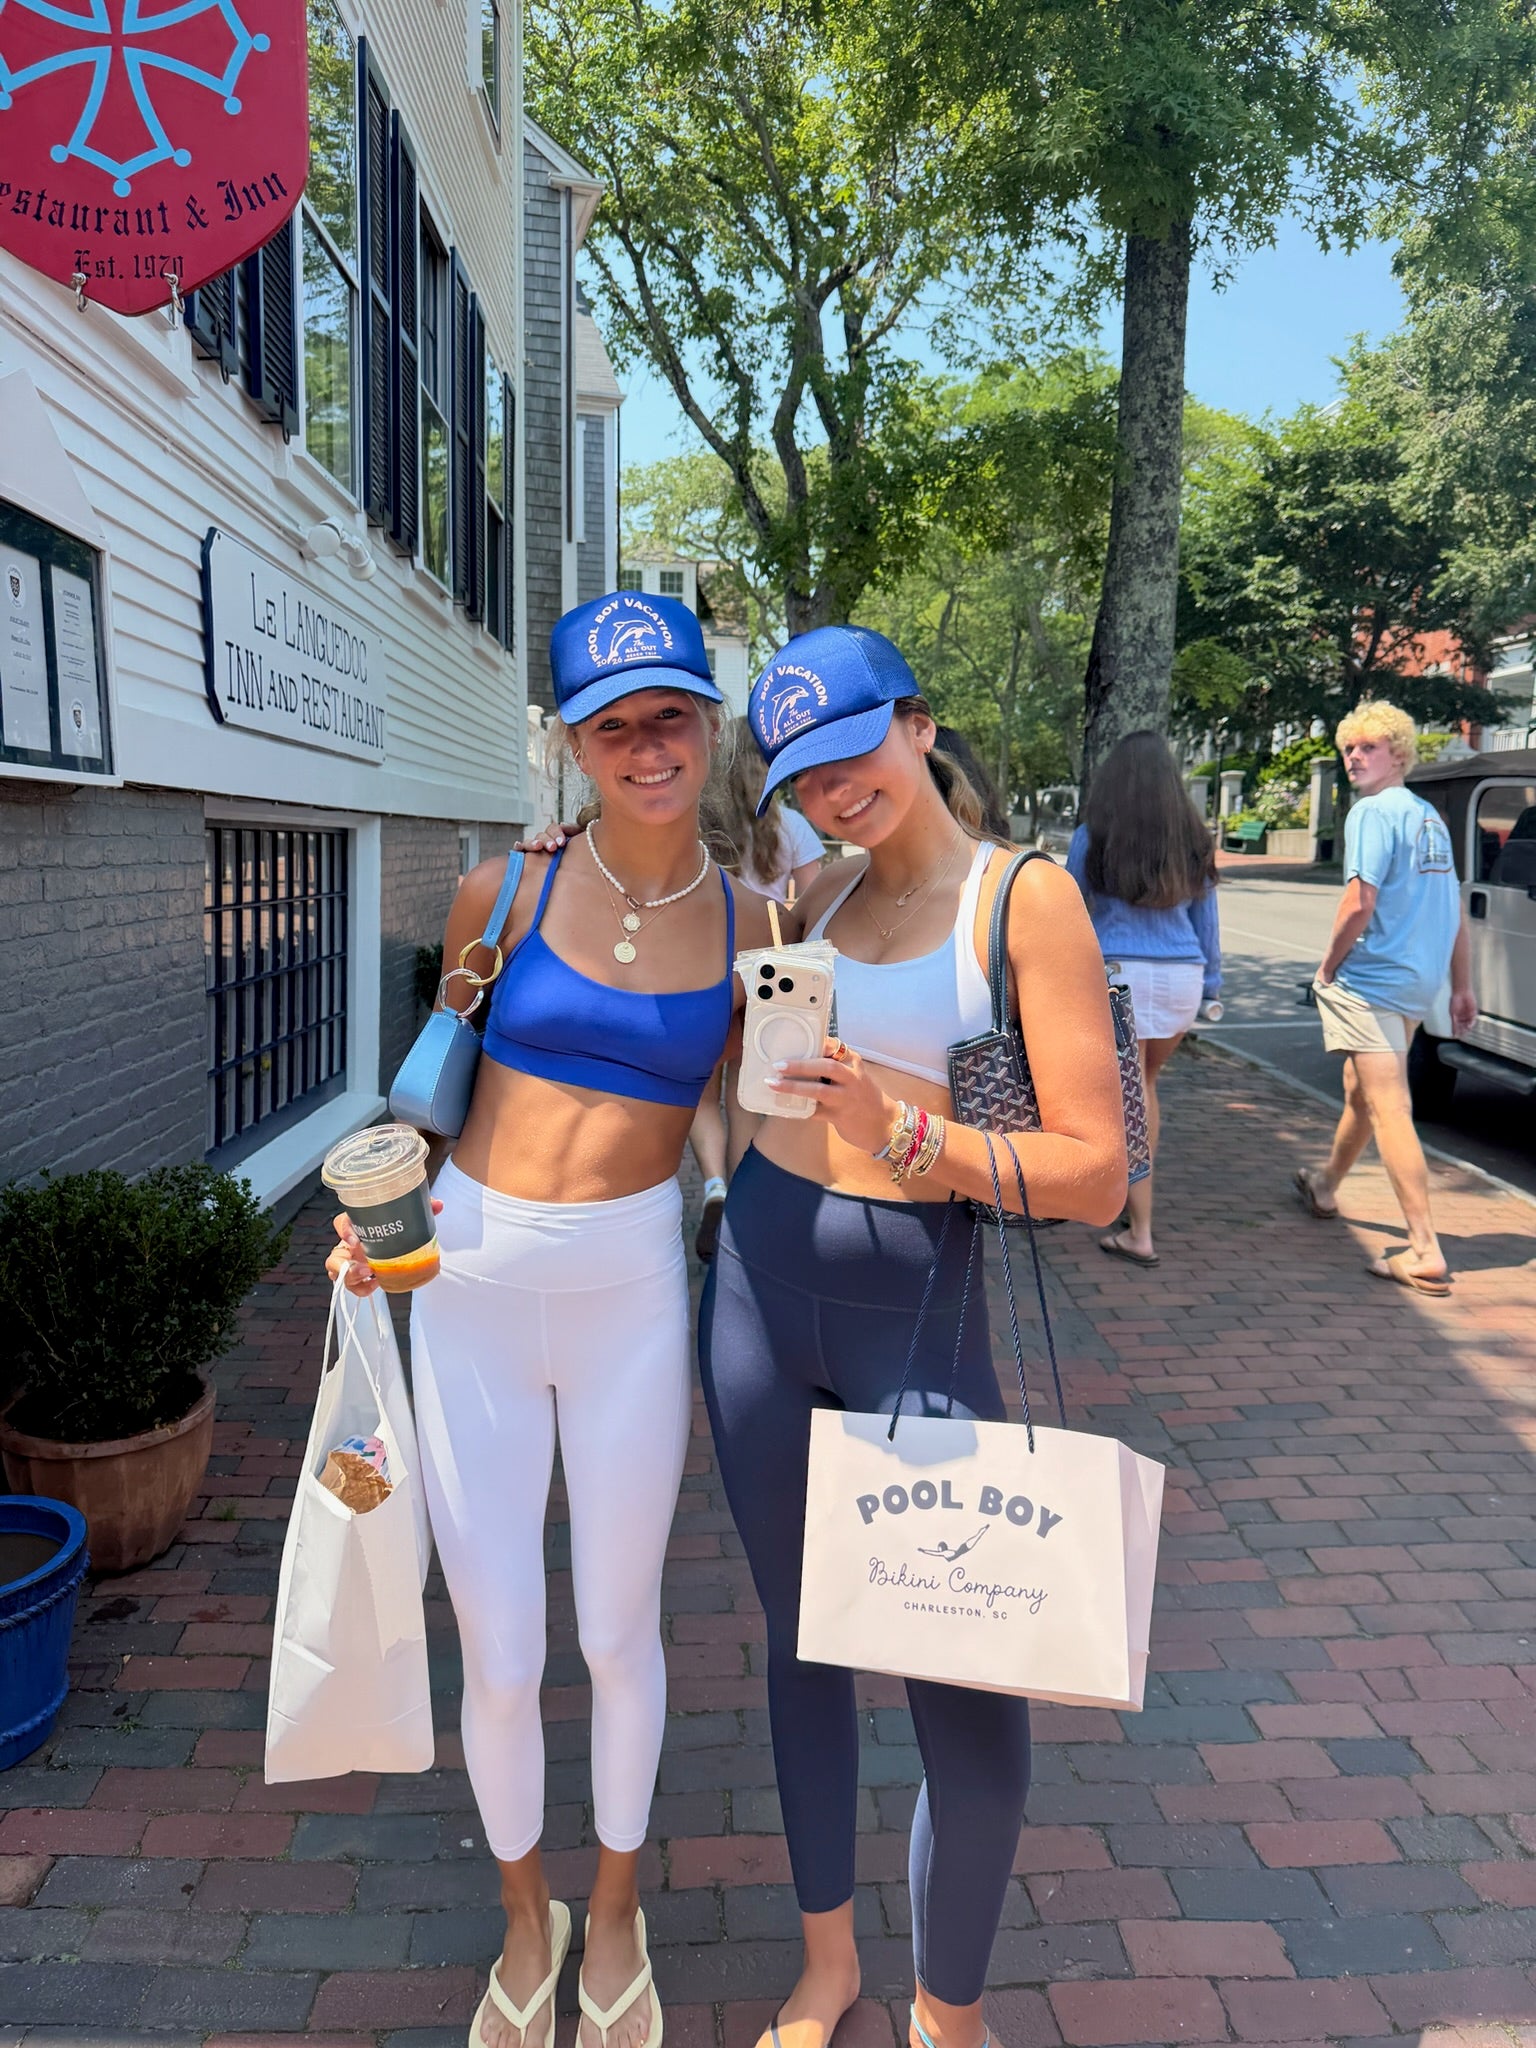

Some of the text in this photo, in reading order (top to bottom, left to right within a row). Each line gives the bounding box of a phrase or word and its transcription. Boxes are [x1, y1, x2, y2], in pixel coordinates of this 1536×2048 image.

[186, 194, 209, 230] &
[216, 172, 288, 222] Inn
[73, 249, 184, 280] Est. 1970
[283, 591, 368, 686] LANGUEDOC
[588, 598, 673, 662] POOL BOY VACATION
[225, 641, 385, 750] INN AND RESTAURANT
[760, 672, 773, 701] BOY
[777, 665, 828, 706] VACATION
[784, 719, 794, 729] ALL
[795, 709, 811, 720] OUT
[367, 1219, 404, 1238] PRESS
[855, 1479, 1063, 1539] POOL BOY
[868, 1557, 1048, 1615] Bikini Company
[993, 1610, 1008, 1620] SC
